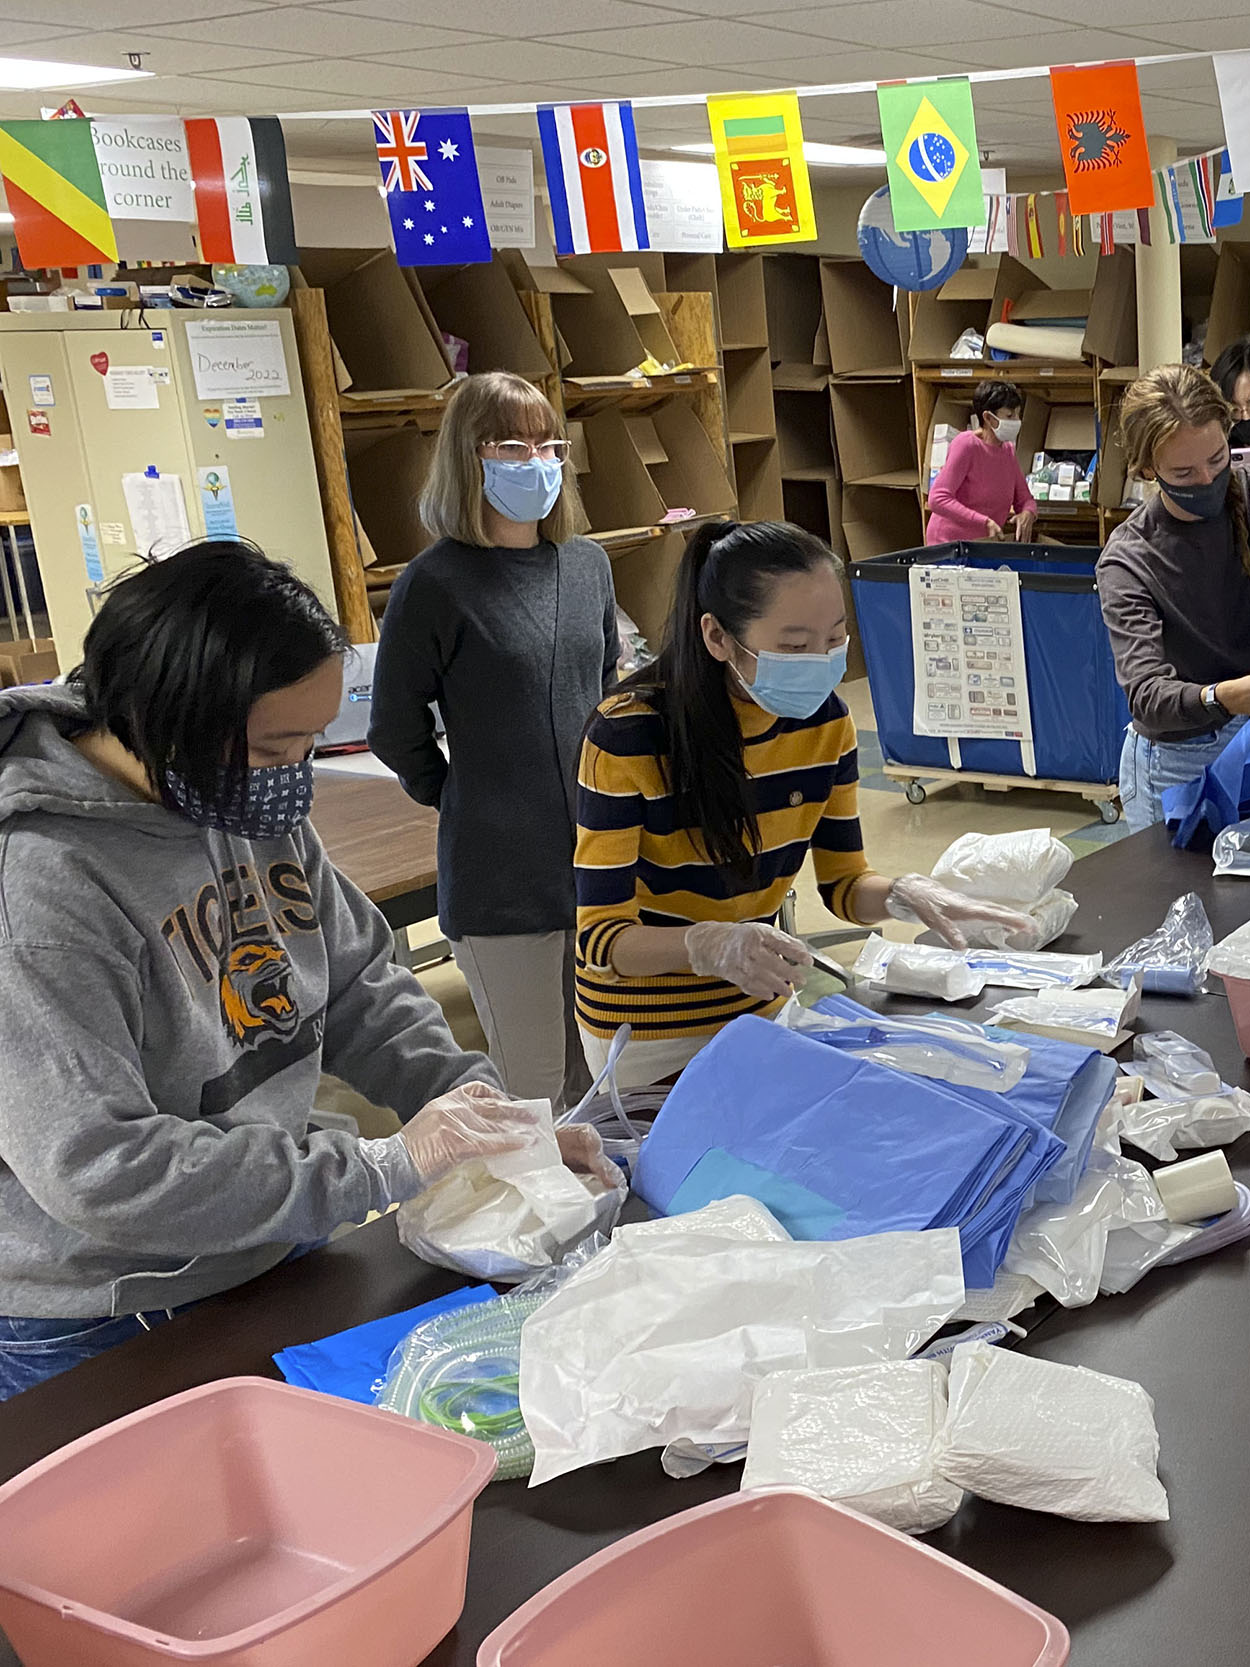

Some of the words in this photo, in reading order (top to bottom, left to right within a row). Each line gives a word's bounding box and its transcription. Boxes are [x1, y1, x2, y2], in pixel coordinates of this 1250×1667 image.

[100, 159, 156, 179] round
[161, 161, 188, 181] the
[113, 192, 173, 209] corner
[197, 353, 254, 373] December
[245, 369, 282, 381] 2022
